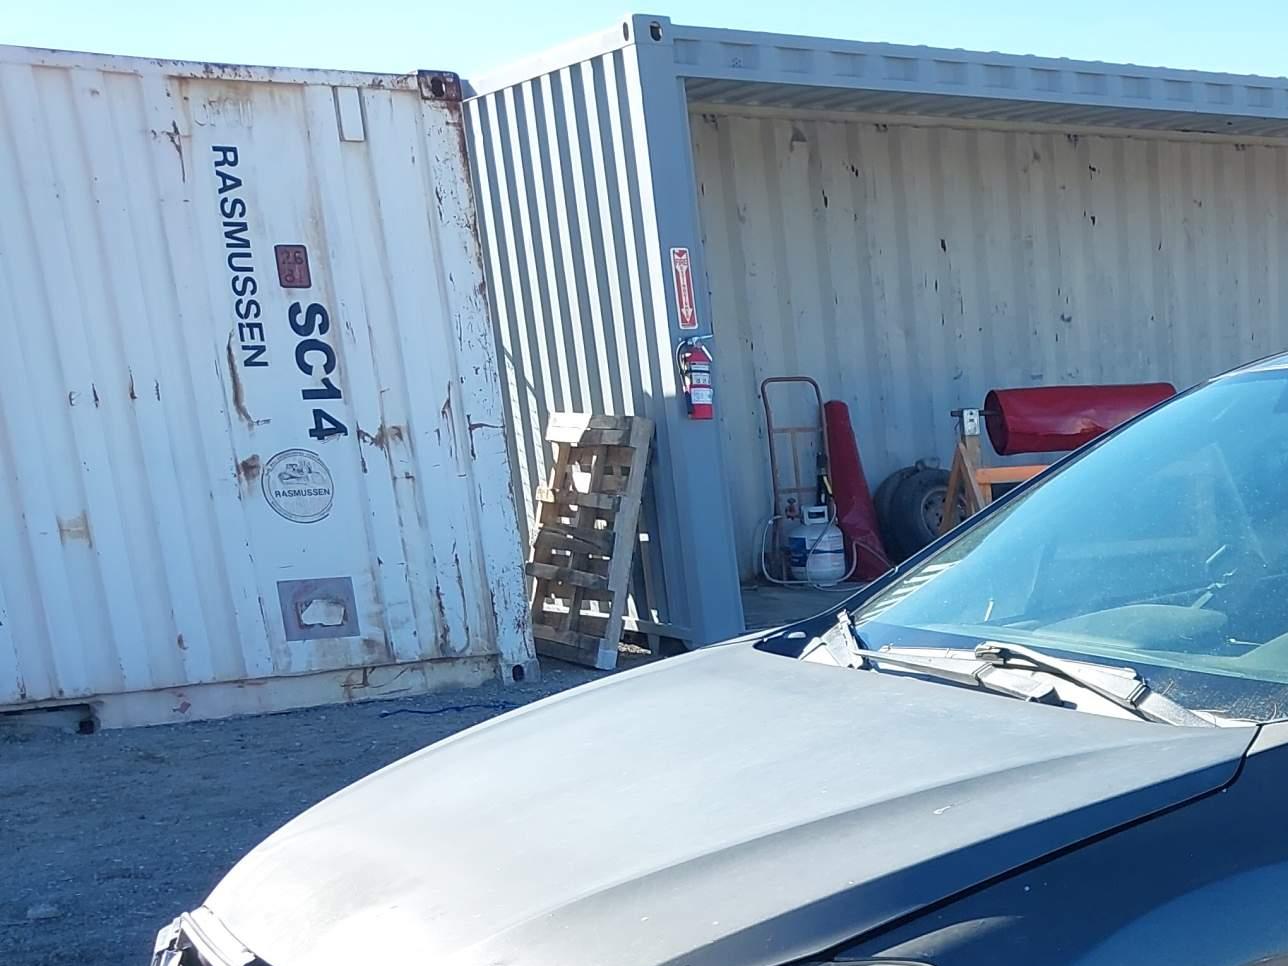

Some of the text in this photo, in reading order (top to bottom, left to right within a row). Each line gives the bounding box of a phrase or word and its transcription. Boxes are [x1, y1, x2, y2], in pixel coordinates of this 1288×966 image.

[211, 145, 269, 367] RASMUSSEN
[288, 301, 348, 441] SC14
[274, 487, 330, 498] RASMUSSEN
